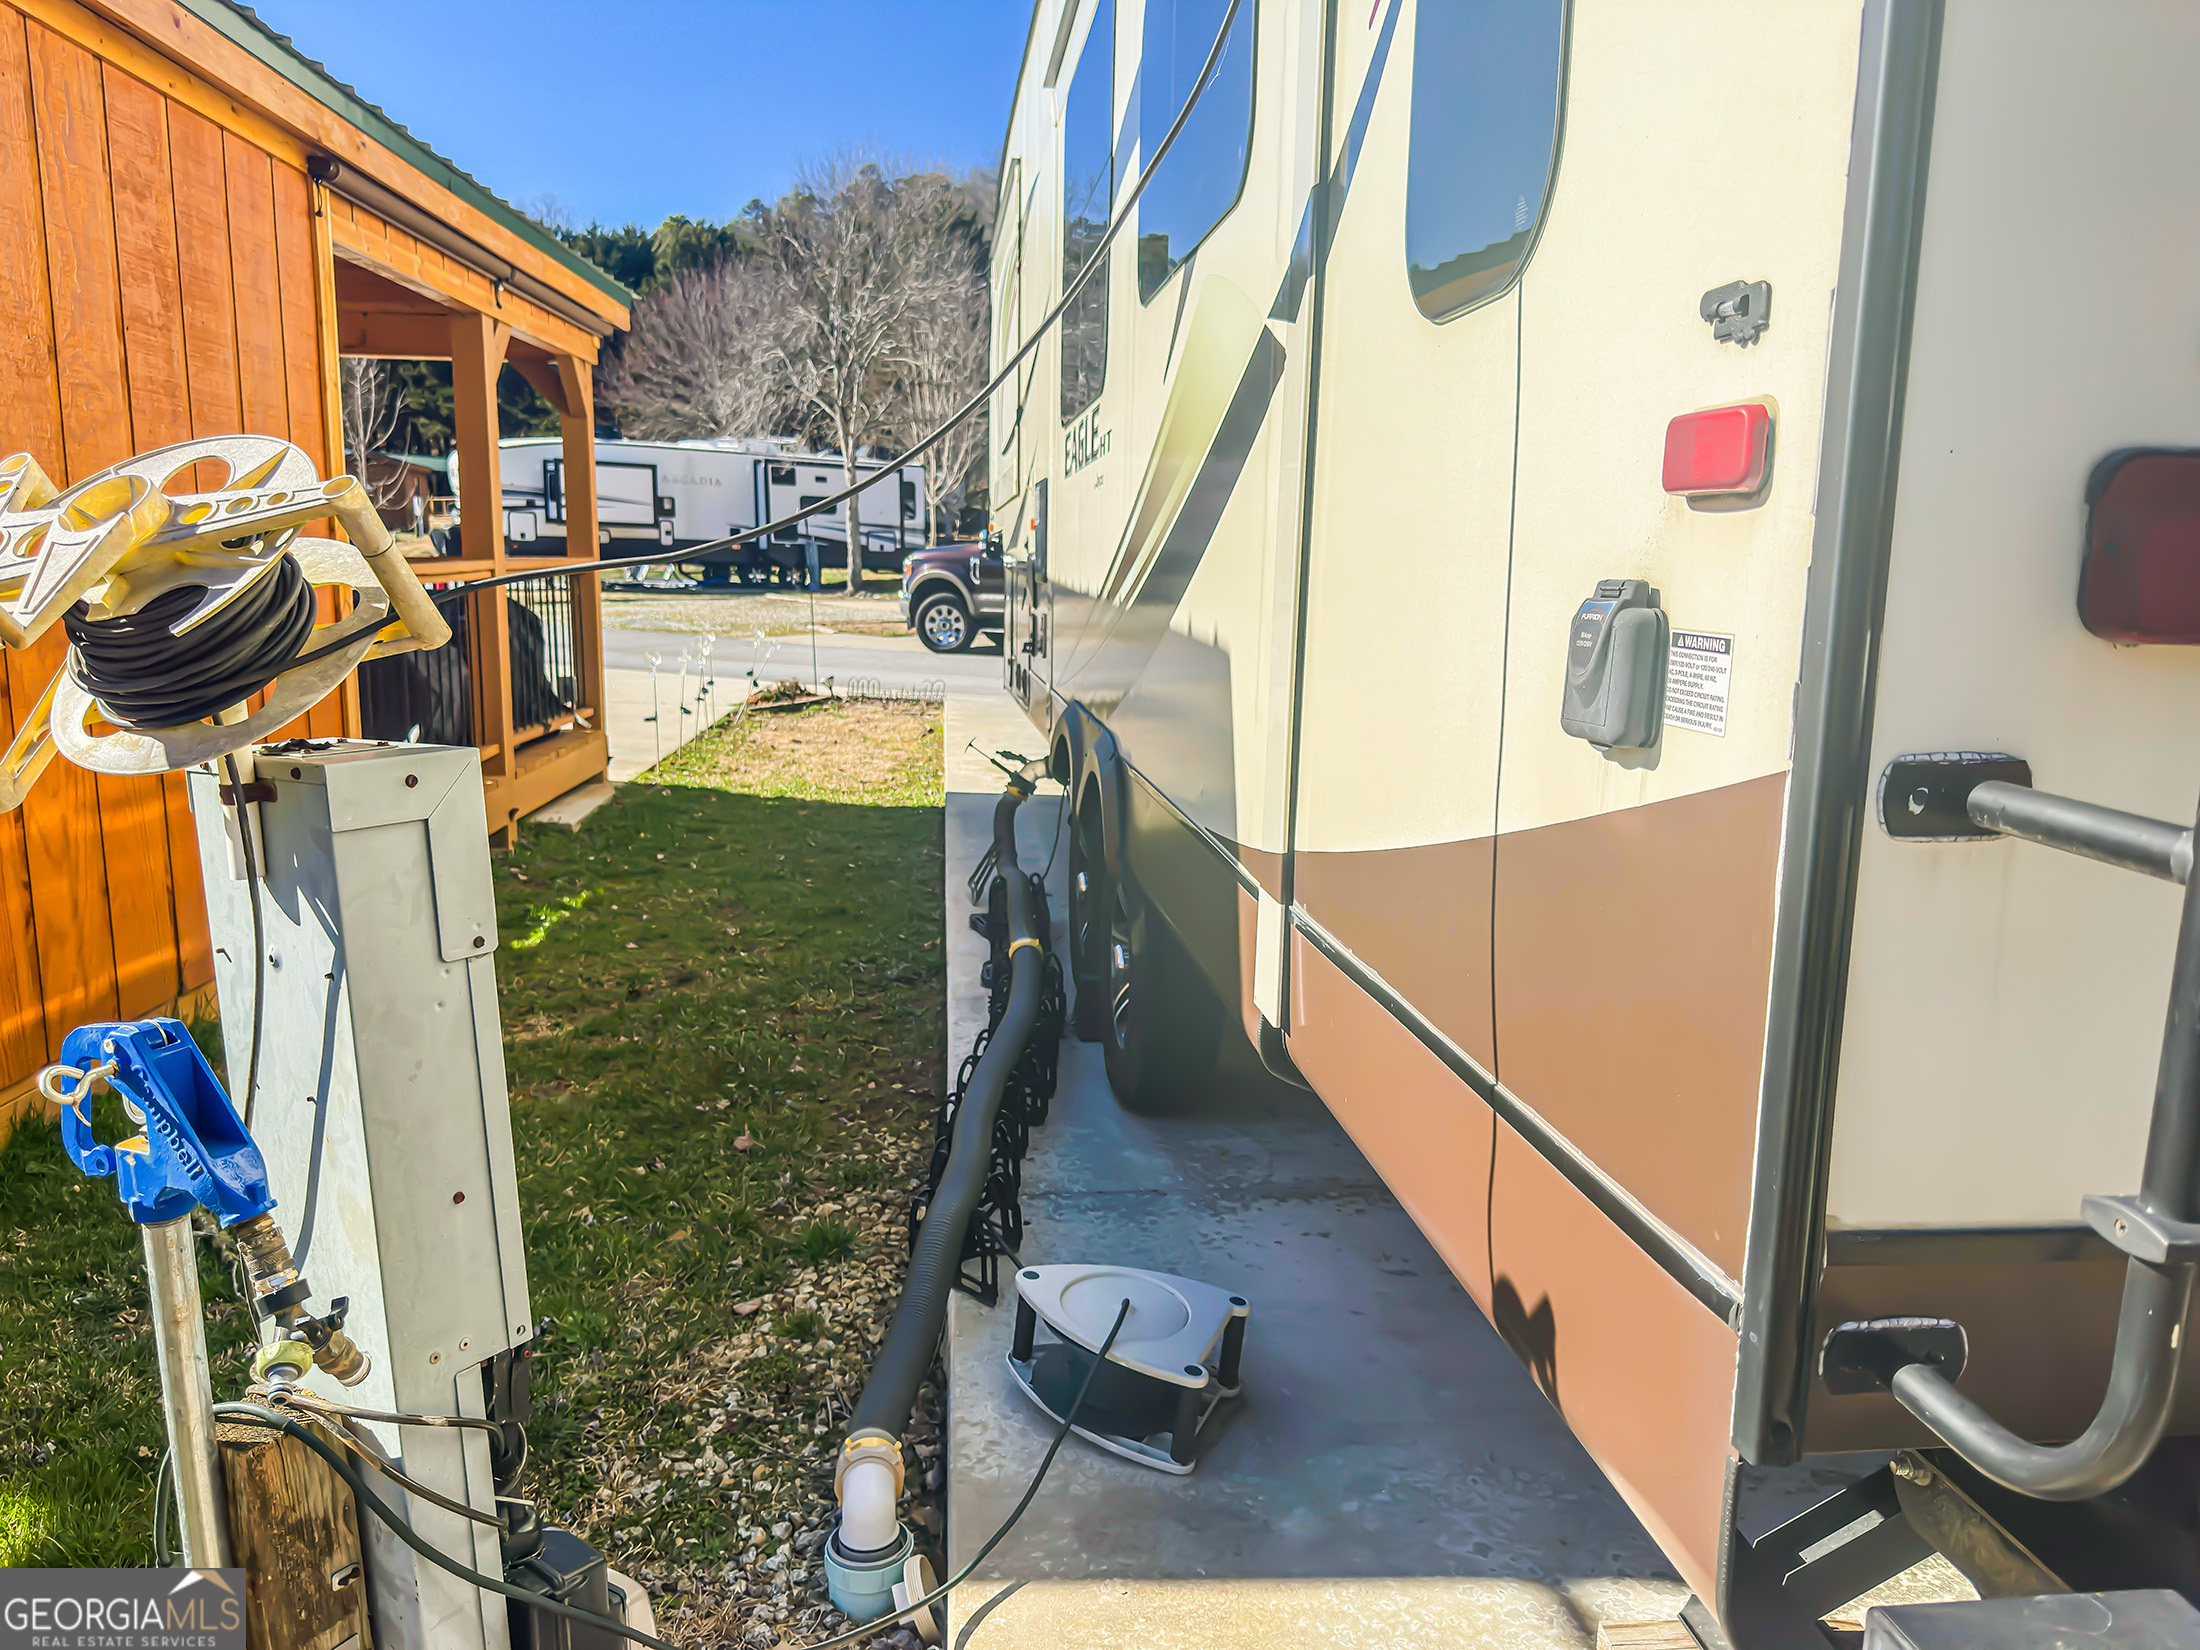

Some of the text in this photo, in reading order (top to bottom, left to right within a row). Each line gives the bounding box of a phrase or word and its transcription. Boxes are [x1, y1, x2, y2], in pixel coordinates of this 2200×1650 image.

[1065, 403, 1112, 480] EAGLE HT
[1685, 635, 1726, 653] WARNING
[1679, 651, 1704, 661] CONNECTION
[1672, 678, 1687, 687] AMPERE
[1688, 681, 1704, 690] SUPPLY.
[1680, 689, 1694, 697] EXCEED
[1694, 691, 1709, 700] CIRCUIT
[1710, 695, 1724, 703] RATING.
[1672, 706, 1684, 714] CAUSE
[1704, 712, 1718, 721] RESULT
[1693, 701, 1709, 709] CIRCUIT
[1709, 704, 1723, 713] RATING
[1681, 717, 1697, 726] SERIOUS
[1698, 721, 1712, 729] INJURY.
